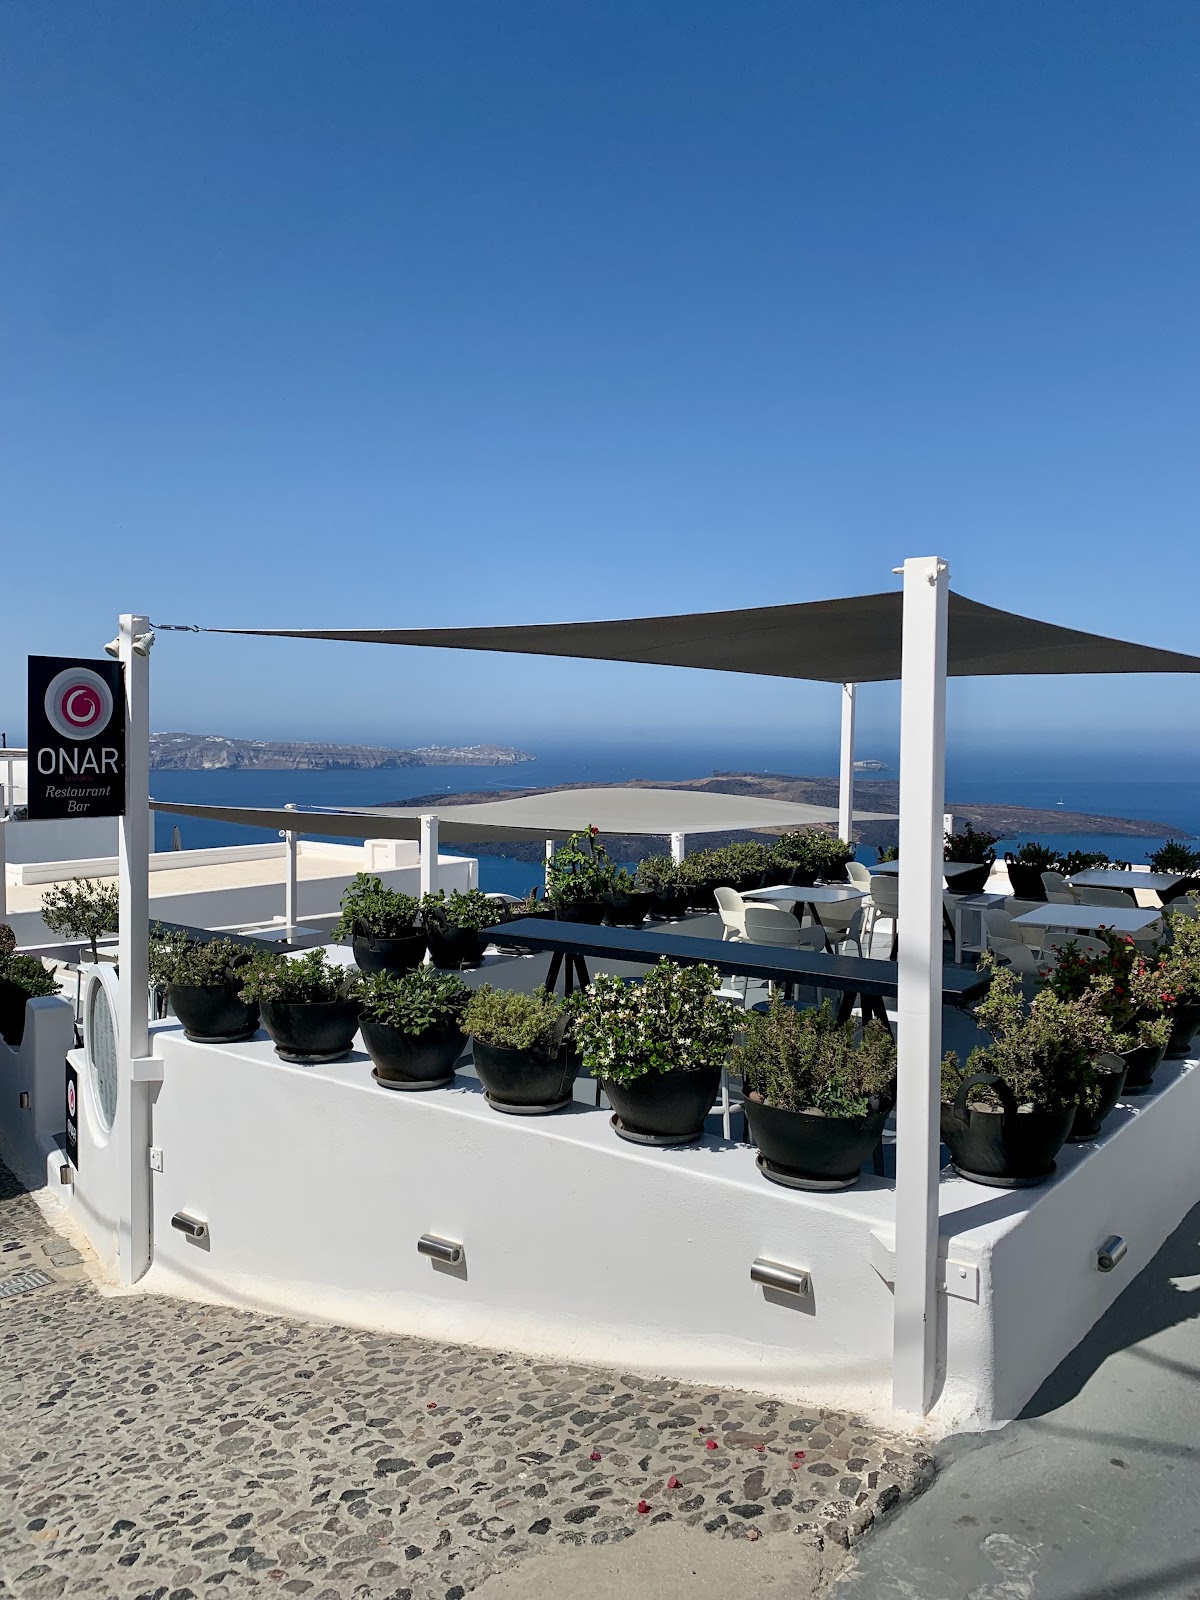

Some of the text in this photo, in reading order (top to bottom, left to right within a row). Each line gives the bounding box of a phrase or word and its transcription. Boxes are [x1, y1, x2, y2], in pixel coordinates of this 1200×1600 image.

[37, 747, 119, 775] ONAR
[45, 785, 111, 798] Restaurant
[67, 800, 91, 812] Bar
